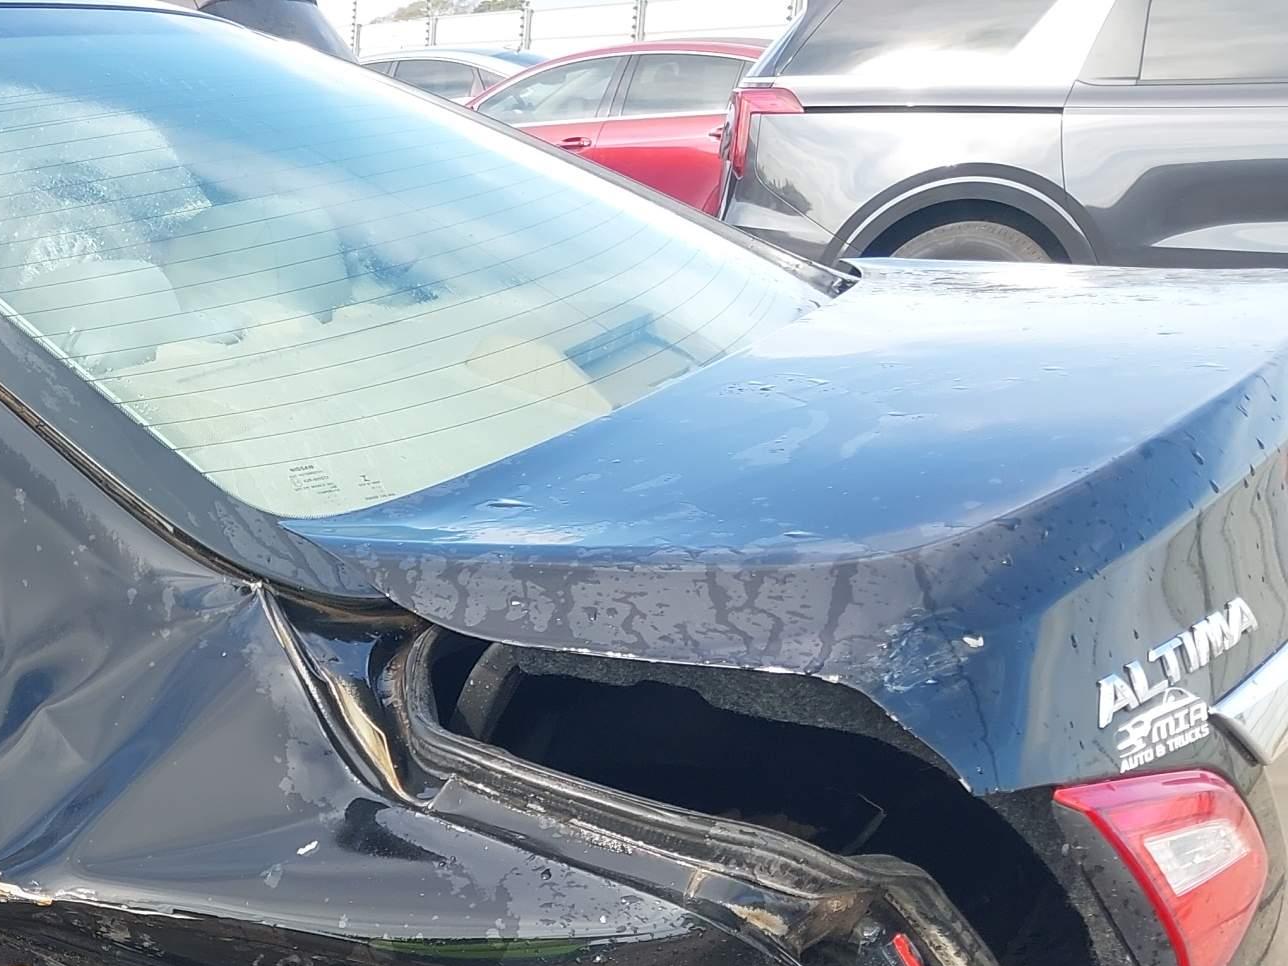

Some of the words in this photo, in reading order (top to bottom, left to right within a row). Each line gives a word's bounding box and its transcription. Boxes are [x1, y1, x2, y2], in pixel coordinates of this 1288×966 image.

[1097, 597, 1259, 728] ALTIMA
[1151, 703, 1209, 743] MIA
[1119, 748, 1154, 774] AUTO
[1155, 742, 1167, 758] &
[1167, 725, 1210, 752] TRUCKS
